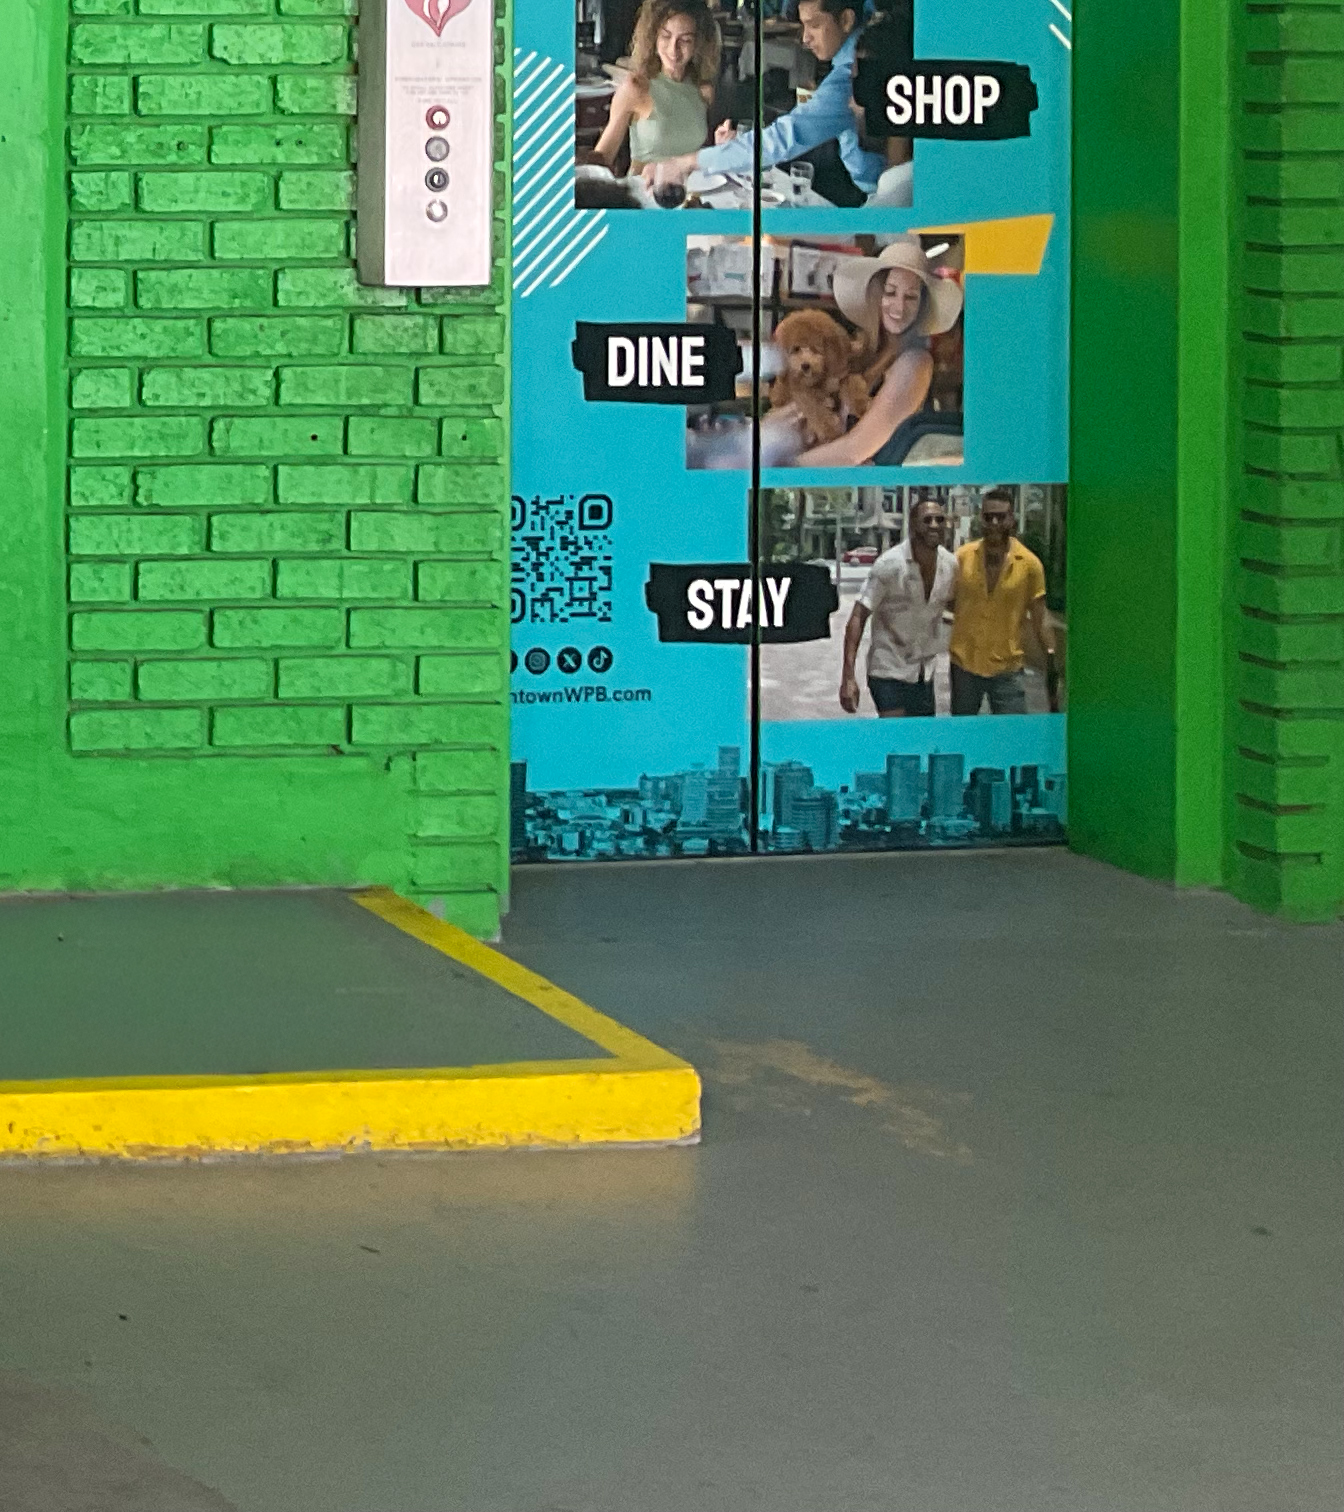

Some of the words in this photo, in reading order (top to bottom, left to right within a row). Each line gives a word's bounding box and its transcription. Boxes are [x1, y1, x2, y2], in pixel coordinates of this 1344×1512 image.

[885, 74, 1001, 126] SHOP
[607, 335, 705, 387] DINE
[687, 577, 791, 630] STAY
